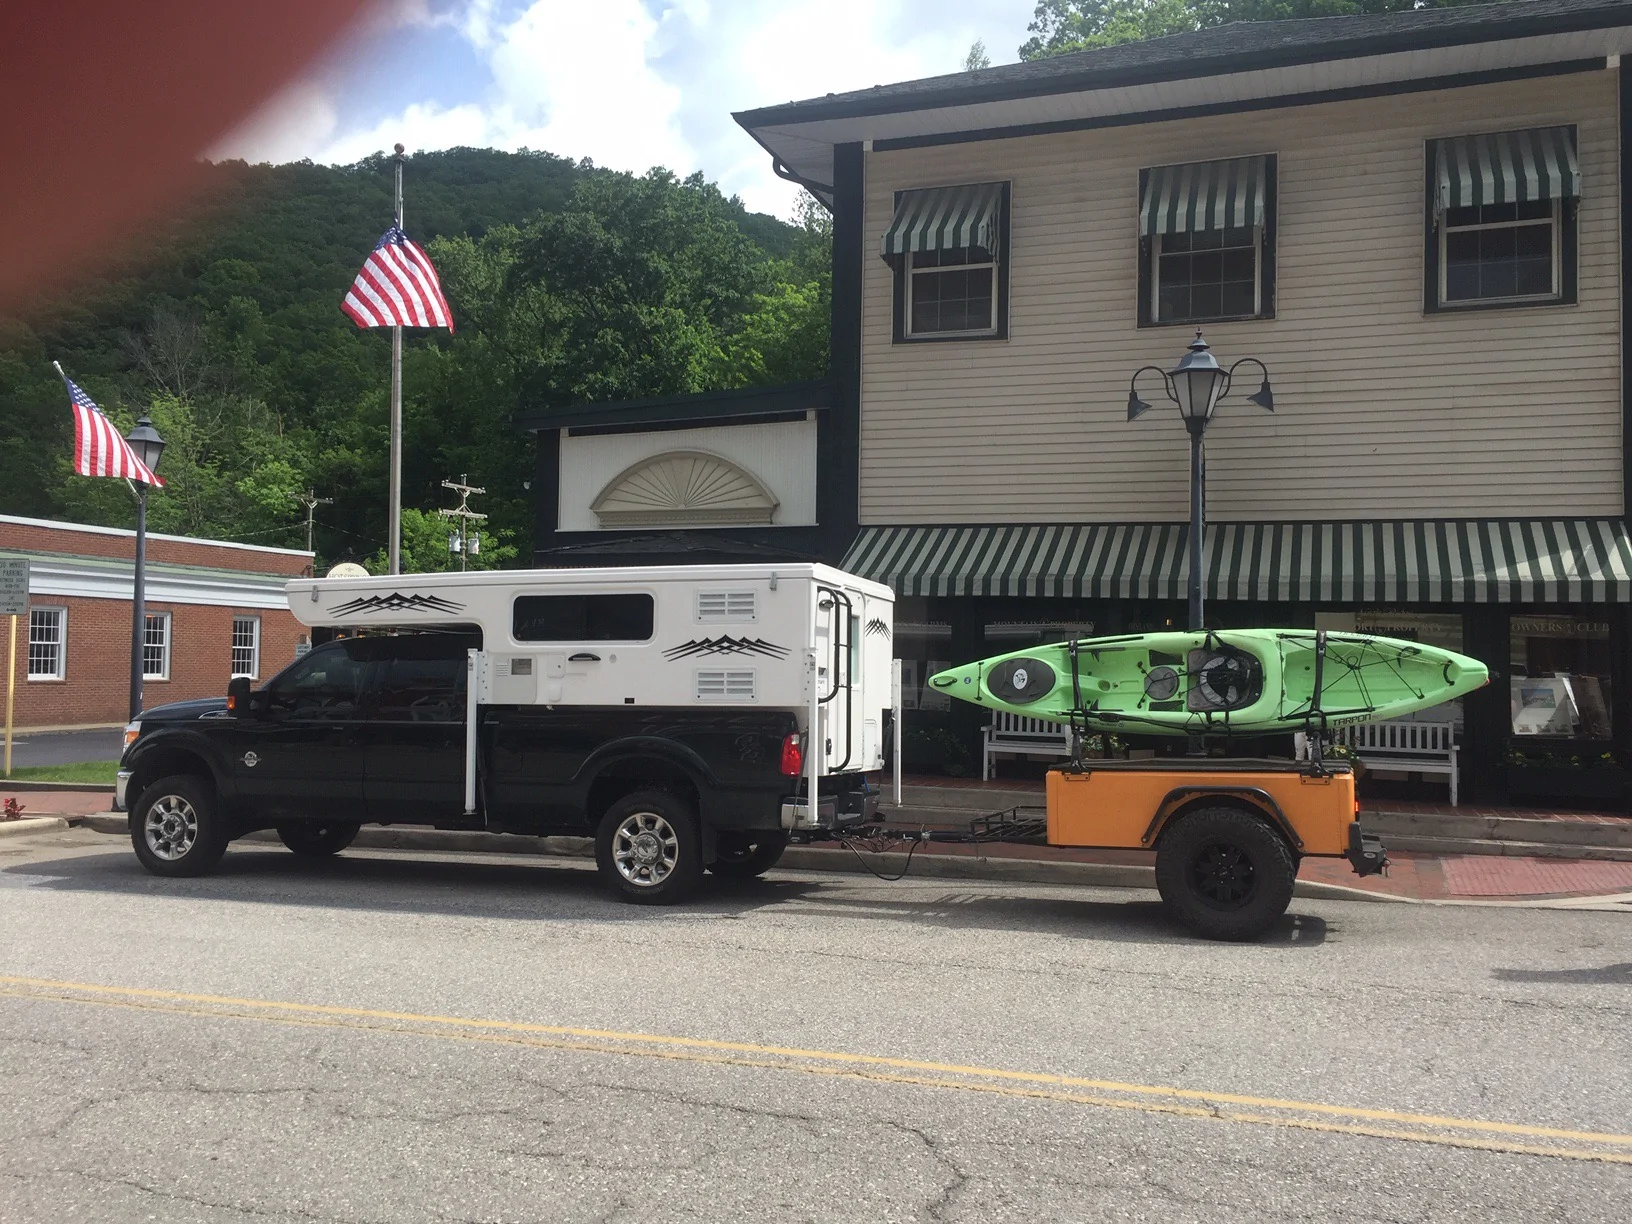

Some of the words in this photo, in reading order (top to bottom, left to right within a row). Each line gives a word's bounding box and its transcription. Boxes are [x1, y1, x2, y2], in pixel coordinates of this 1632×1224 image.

[1511, 622, 1563, 632] OWNERS
[1577, 622, 1610, 632] CLUB
[1333, 713, 1372, 726] TARPON
